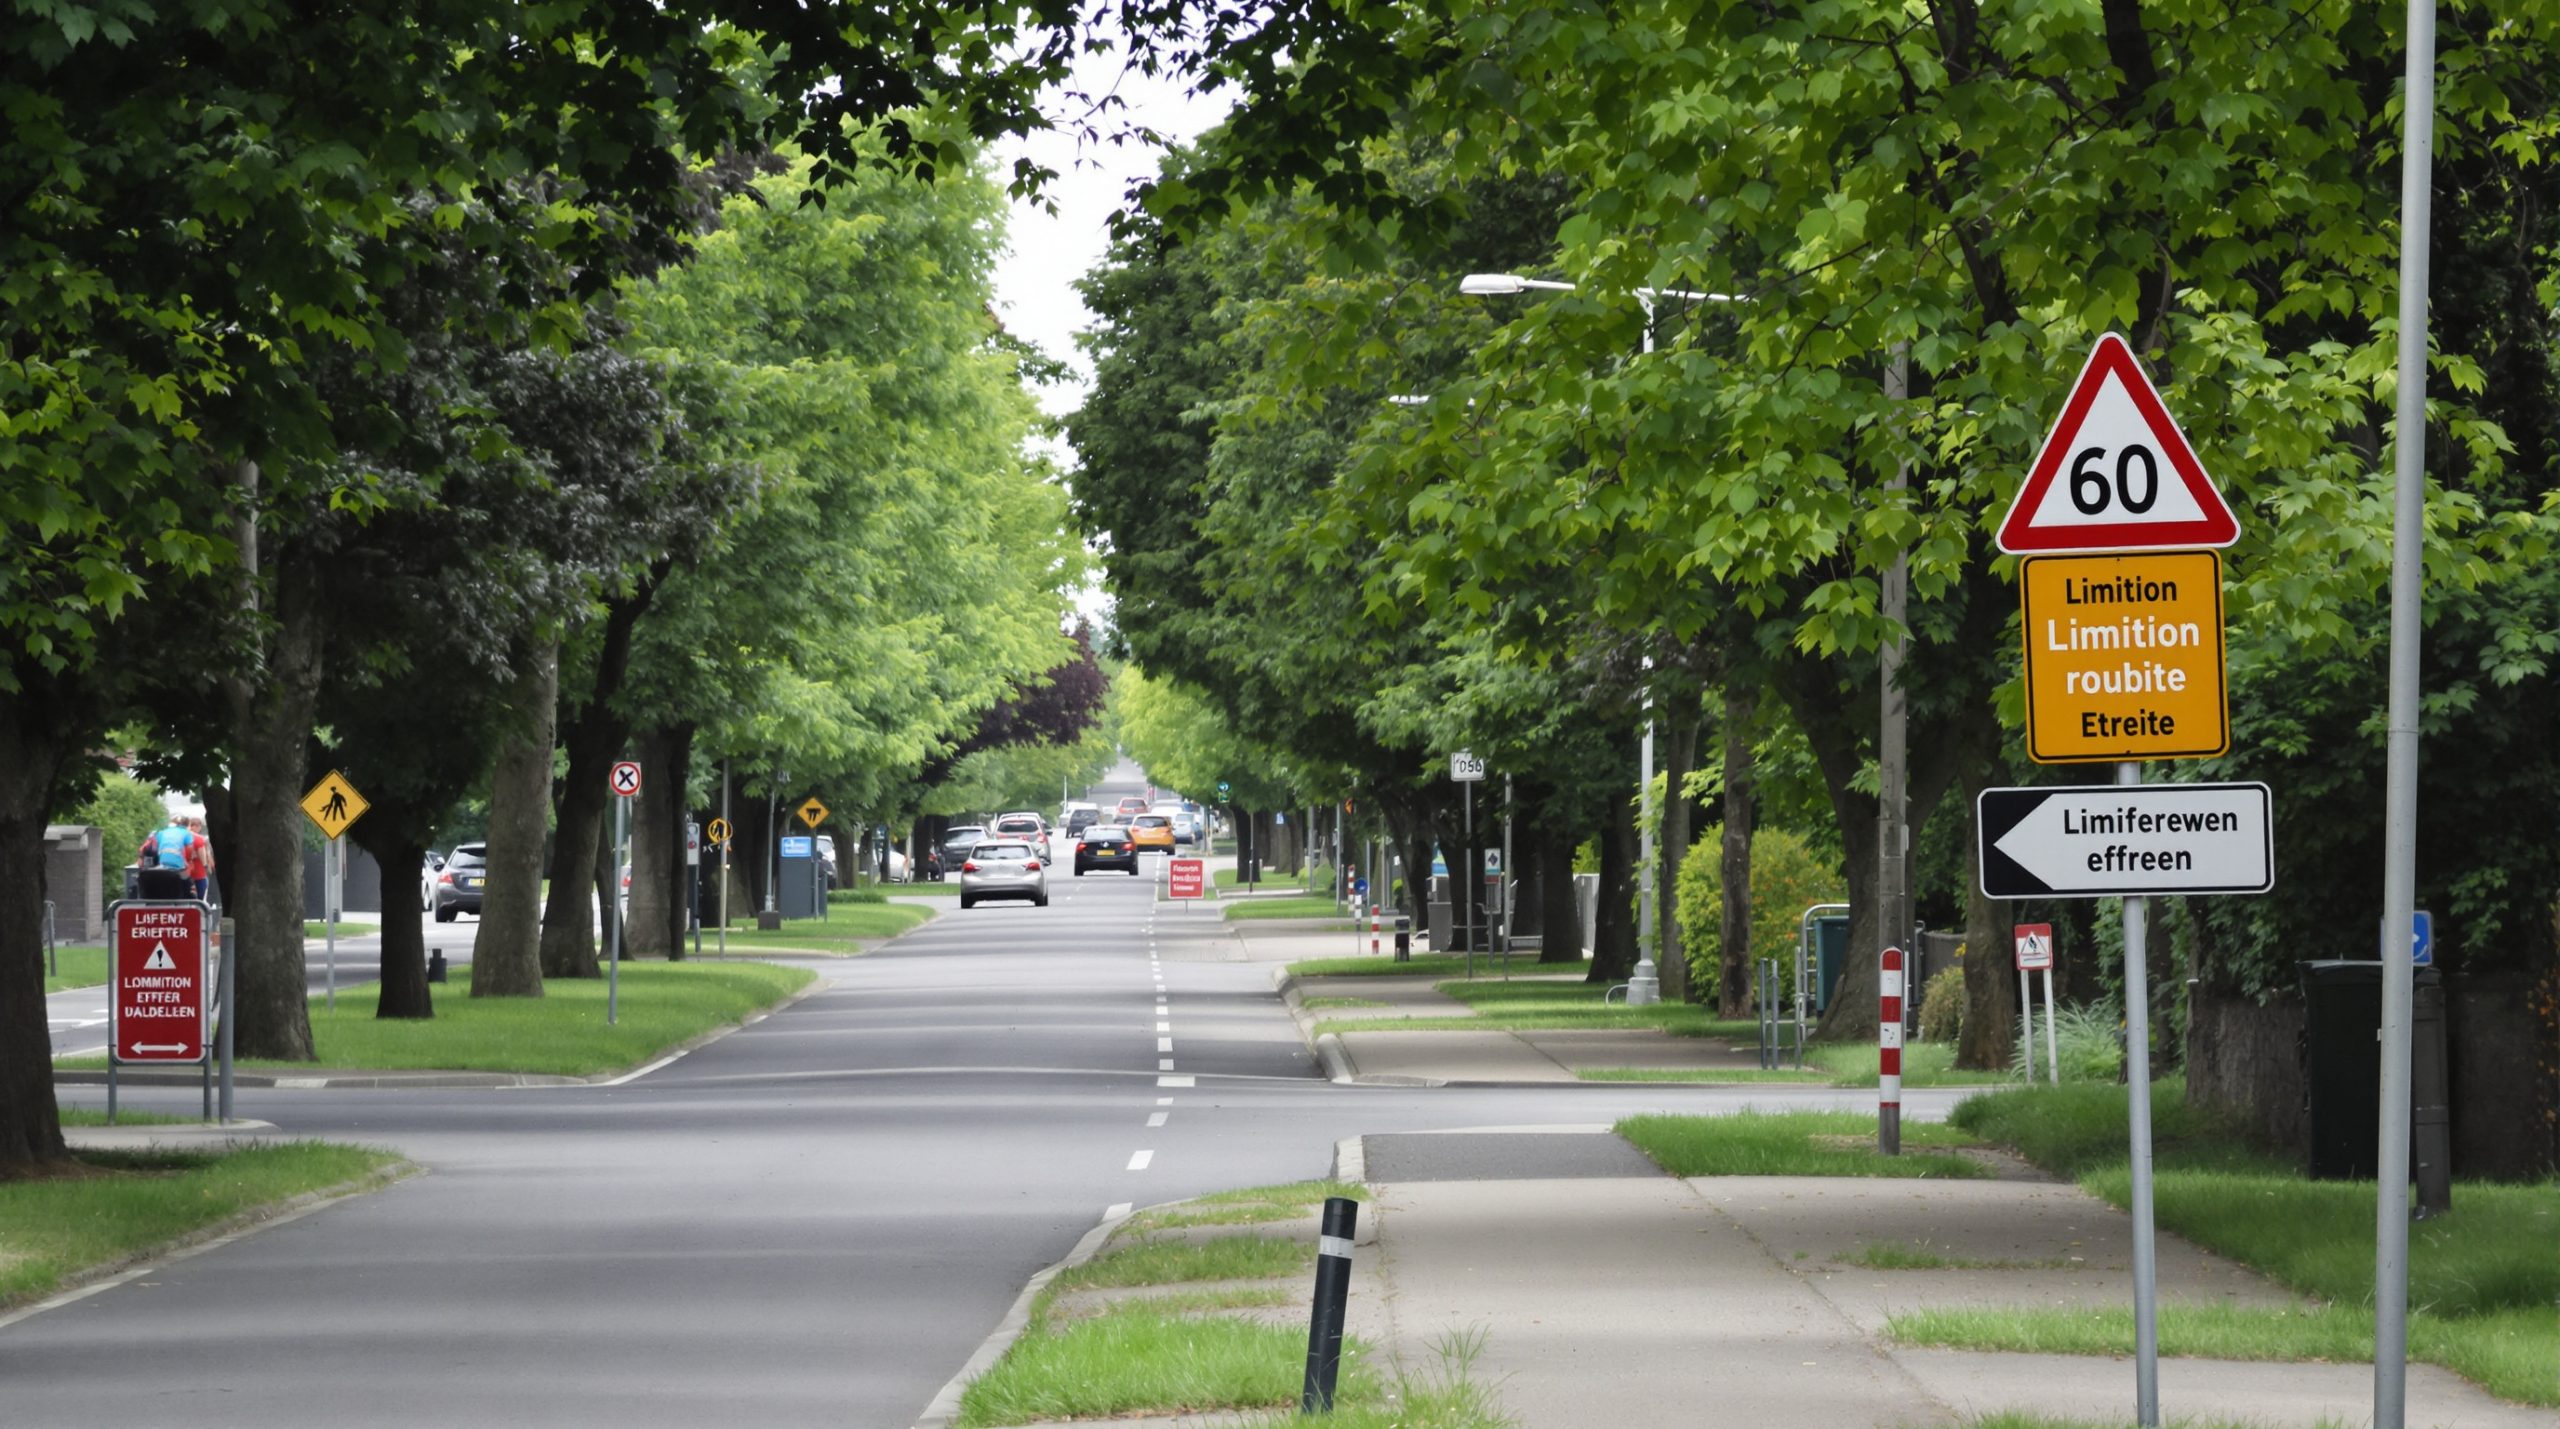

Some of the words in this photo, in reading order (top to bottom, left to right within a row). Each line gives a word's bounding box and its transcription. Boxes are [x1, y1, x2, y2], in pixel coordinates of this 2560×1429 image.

[2069, 443, 2159, 516] 60
[2066, 576, 2177, 604] Limition
[2066, 661, 2186, 694] roubite
[2081, 708, 2175, 738] Etreite
[2063, 807, 2238, 835] Limiferewen
[2087, 845, 2192, 872] effreen
